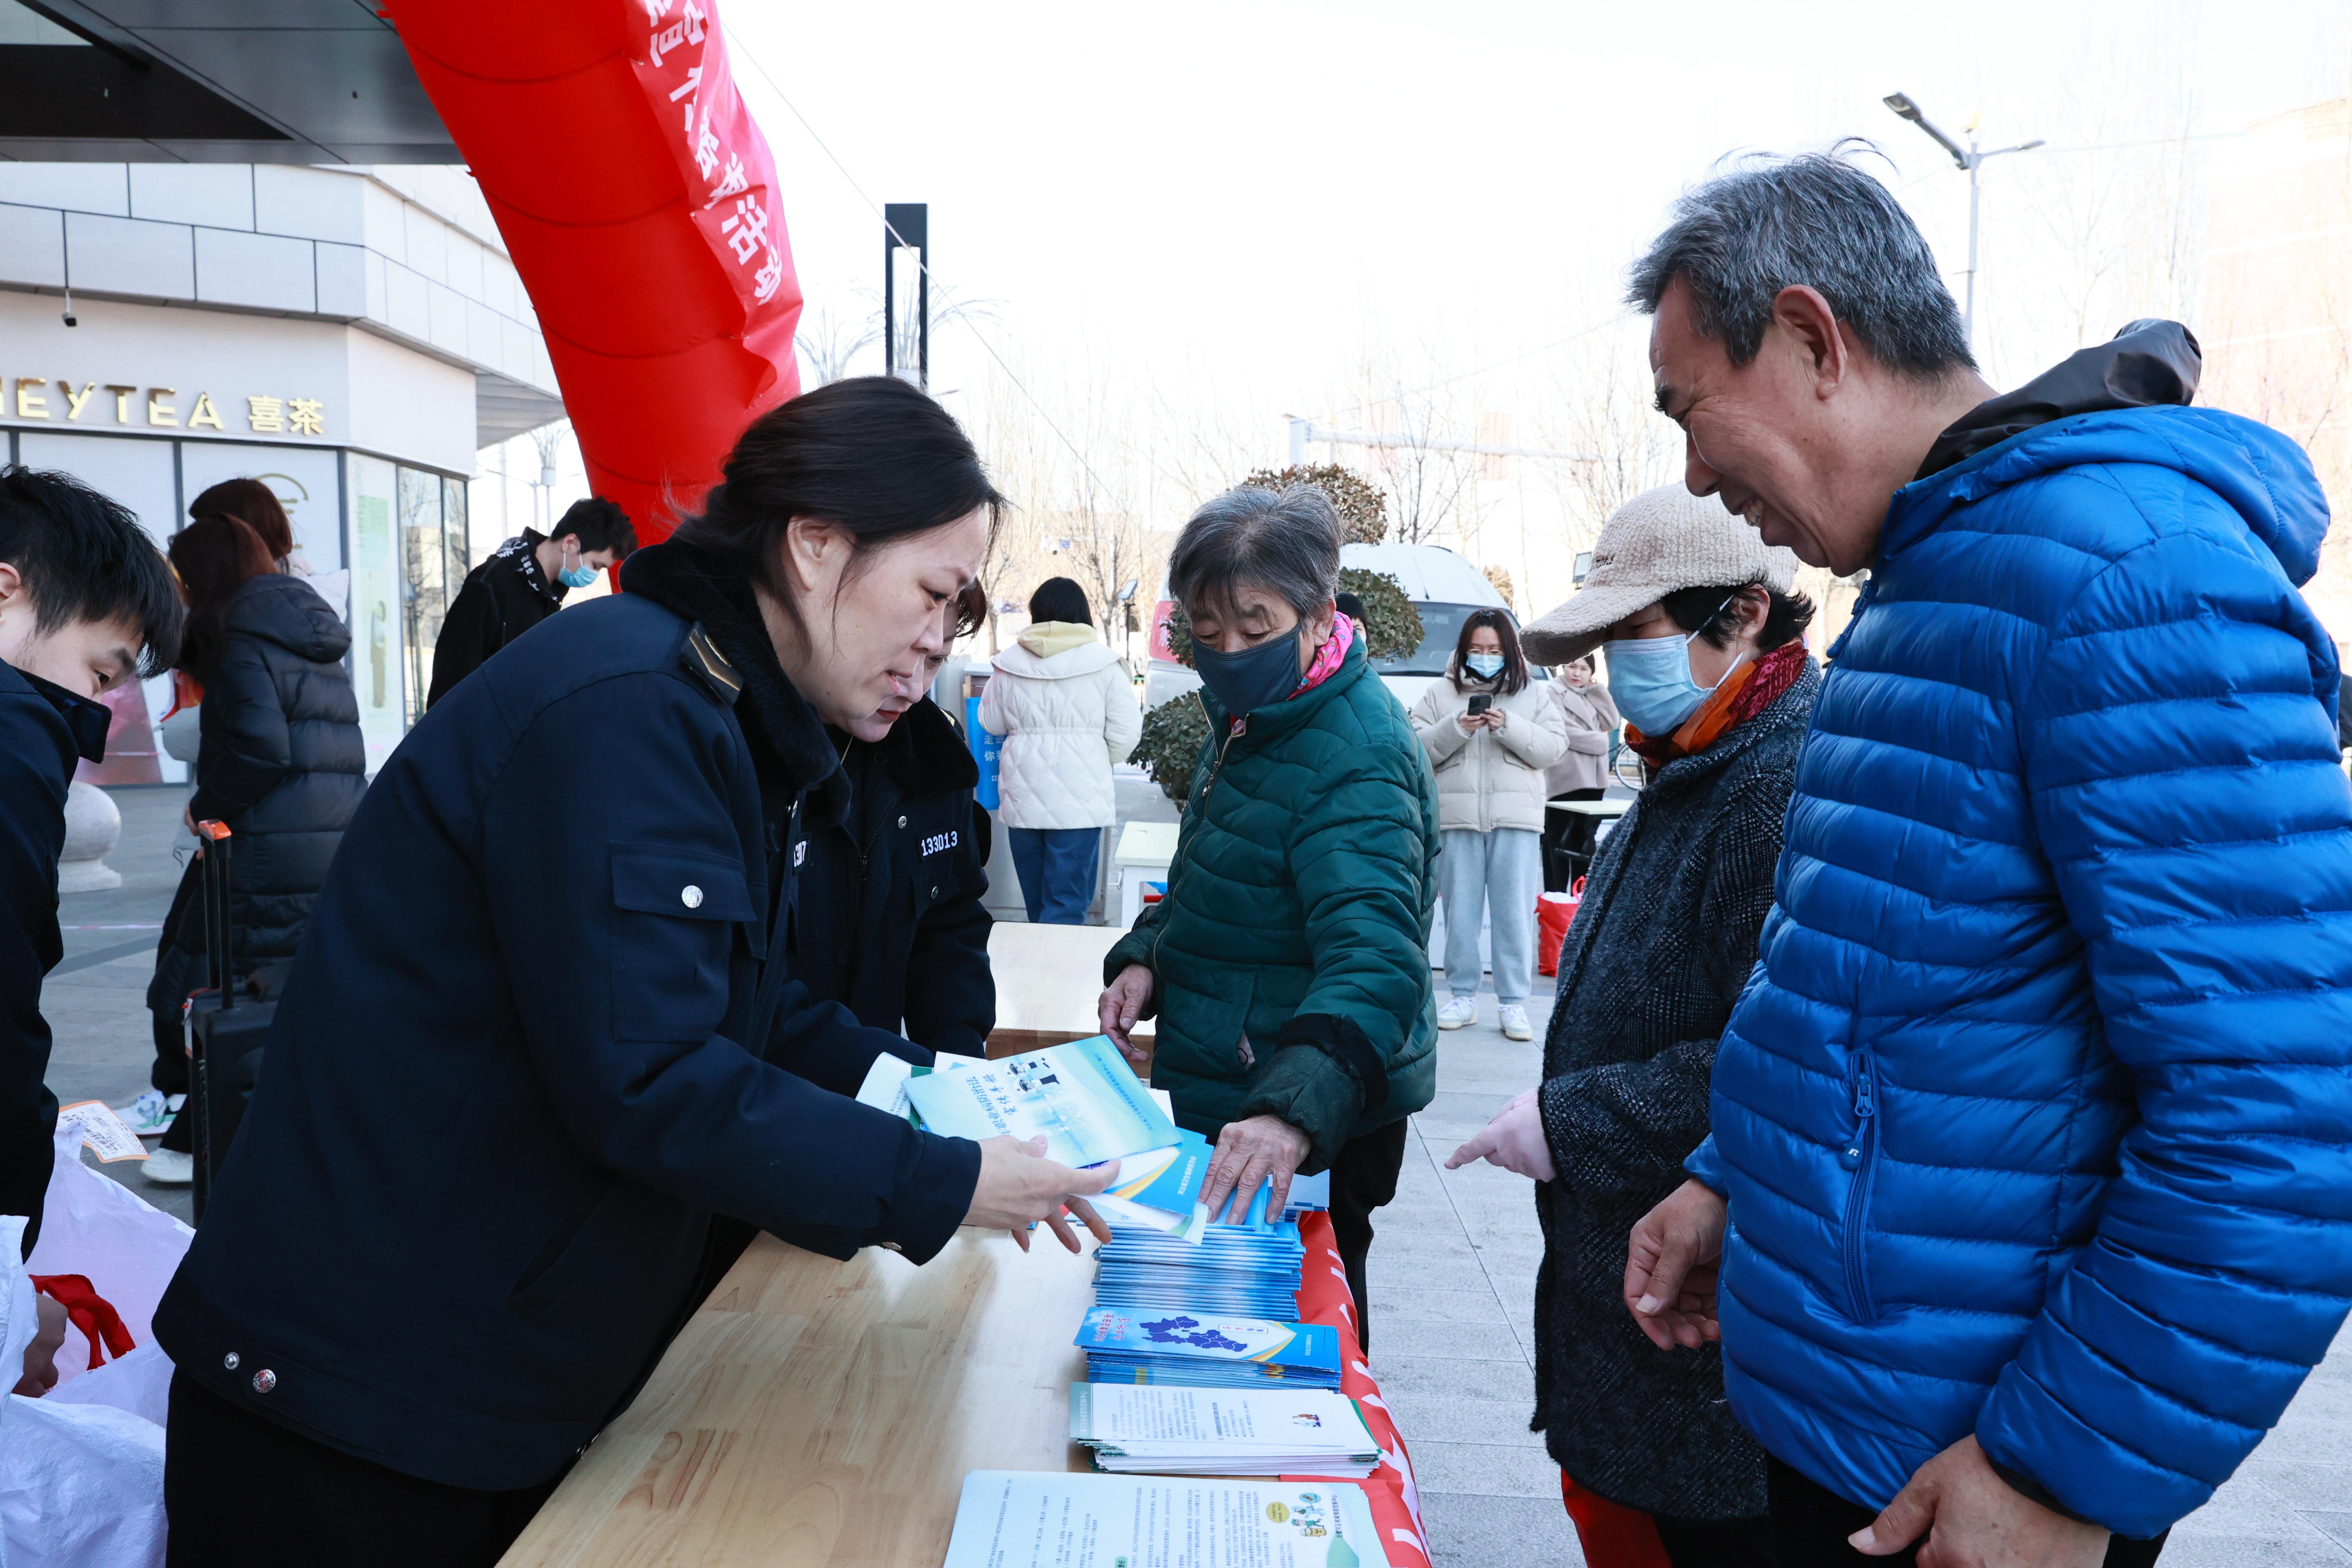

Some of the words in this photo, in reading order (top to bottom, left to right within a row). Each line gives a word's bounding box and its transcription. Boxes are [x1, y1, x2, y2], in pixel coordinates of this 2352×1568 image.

[0, 377, 224, 430] EYTEA
[248, 394, 325, 435] 喜茶
[983, 1074, 1019, 1115] 宣传手册
[1093, 1314, 1115, 1341] 河北省食品安全
